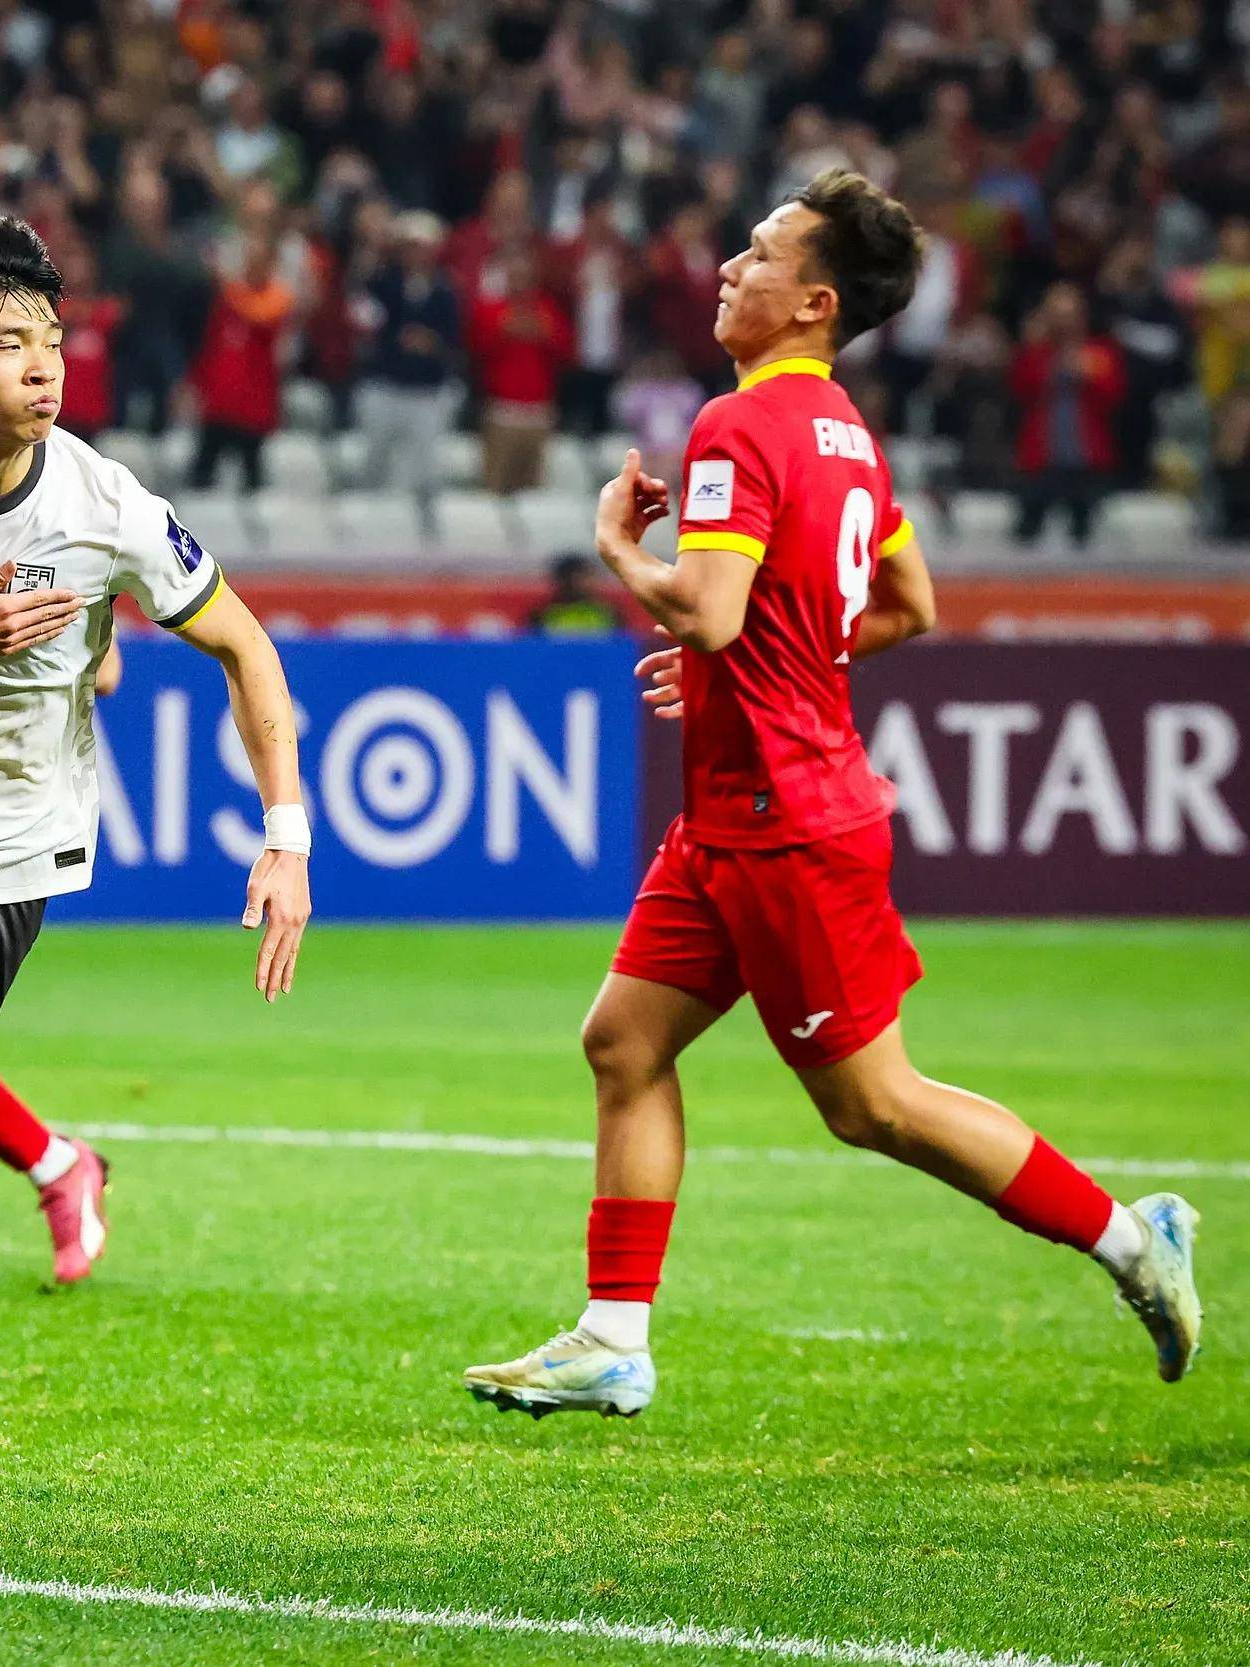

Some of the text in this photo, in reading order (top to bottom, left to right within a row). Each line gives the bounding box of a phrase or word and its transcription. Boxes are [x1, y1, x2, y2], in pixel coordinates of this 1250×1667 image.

[14, 567, 51, 582] CFA
[835, 487, 875, 664] 9
[866, 700, 1248, 855] ATAR
